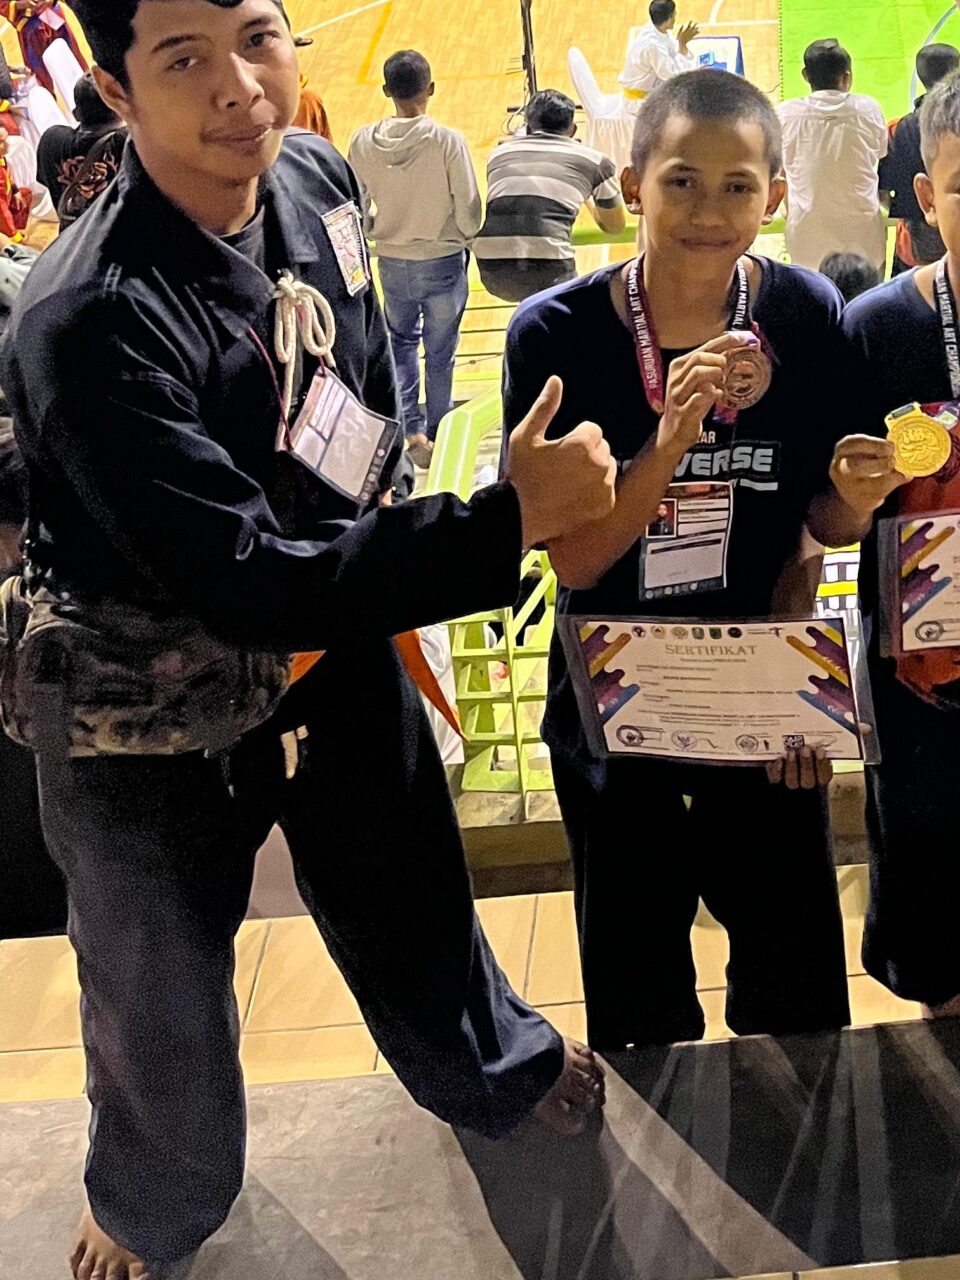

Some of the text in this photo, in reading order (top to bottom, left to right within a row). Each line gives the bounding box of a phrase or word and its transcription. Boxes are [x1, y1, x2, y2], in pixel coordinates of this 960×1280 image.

[630, 295, 643, 312] ART
[733, 292, 747, 325] MARTIAL
[938, 293, 954, 326] MARTIAL
[633, 312, 652, 347] MARTIAL
[943, 327, 957, 344] ART
[641, 347, 659, 389] PASURUAN
[697, 431, 716, 444] AR
[674, 446, 774, 477] VERSE
[664, 644, 758, 656] SERTIFIKAT
